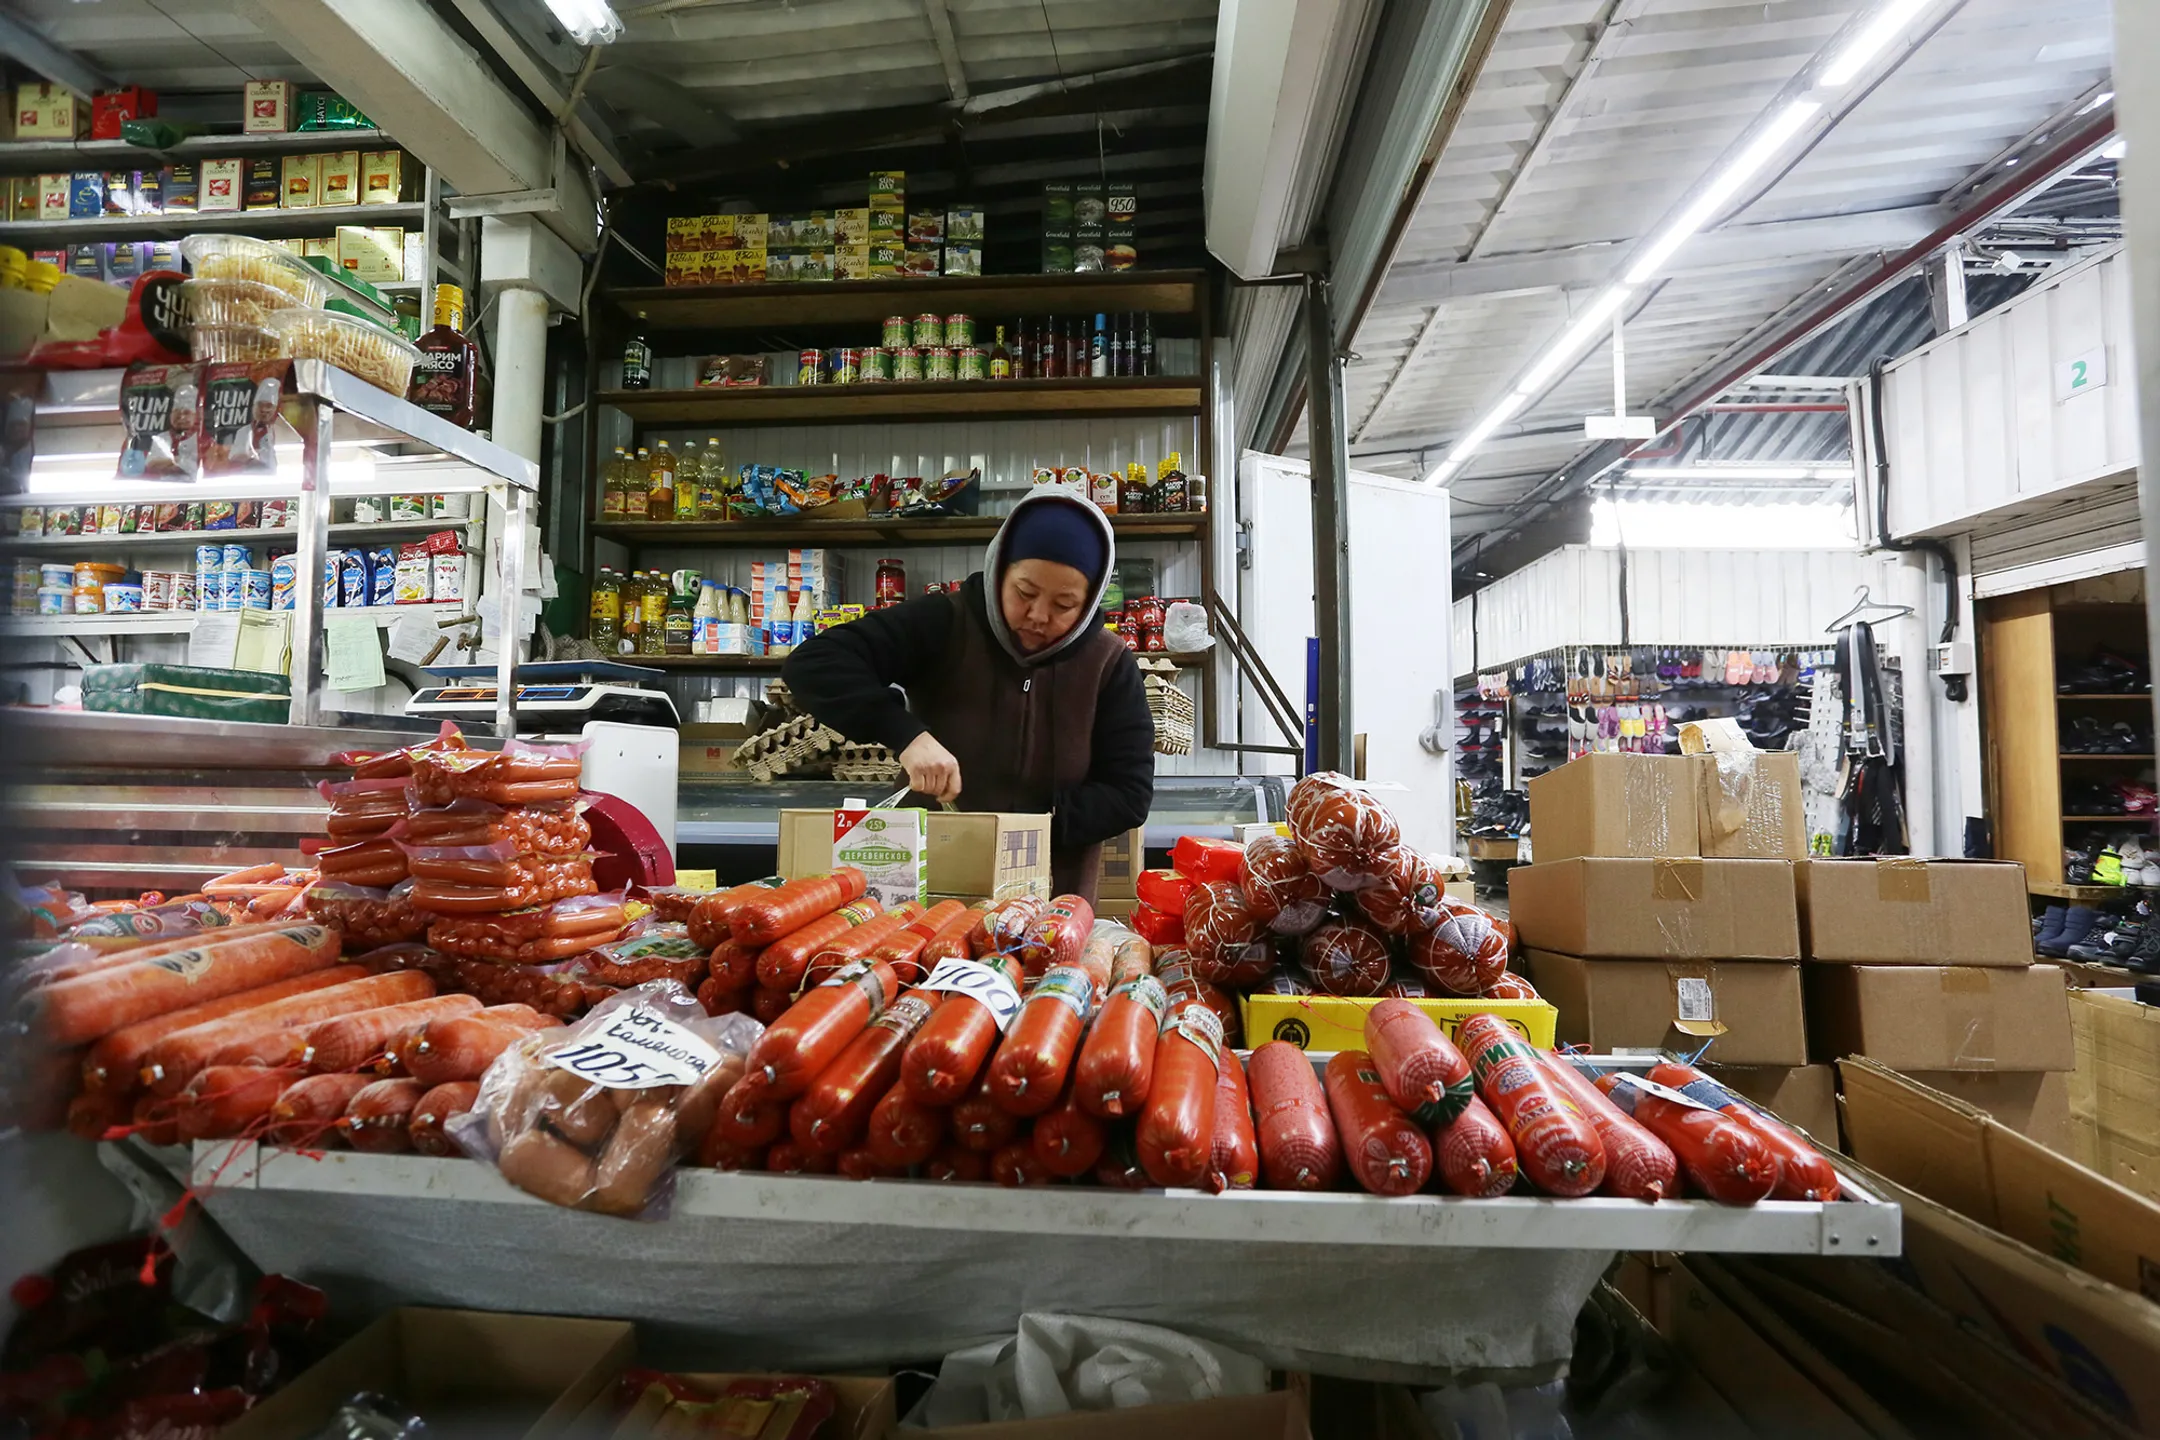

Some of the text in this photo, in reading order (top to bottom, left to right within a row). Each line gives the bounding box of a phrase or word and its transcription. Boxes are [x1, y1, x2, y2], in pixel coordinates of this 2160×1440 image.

[1110, 198, 1135, 212] 950
[423, 352, 462, 363] АРИМ
[2071, 360, 2088, 390] 2
[837, 813, 846, 828] 2
[844, 851, 908, 861] ДЕРЕВЕНСКОЕ
